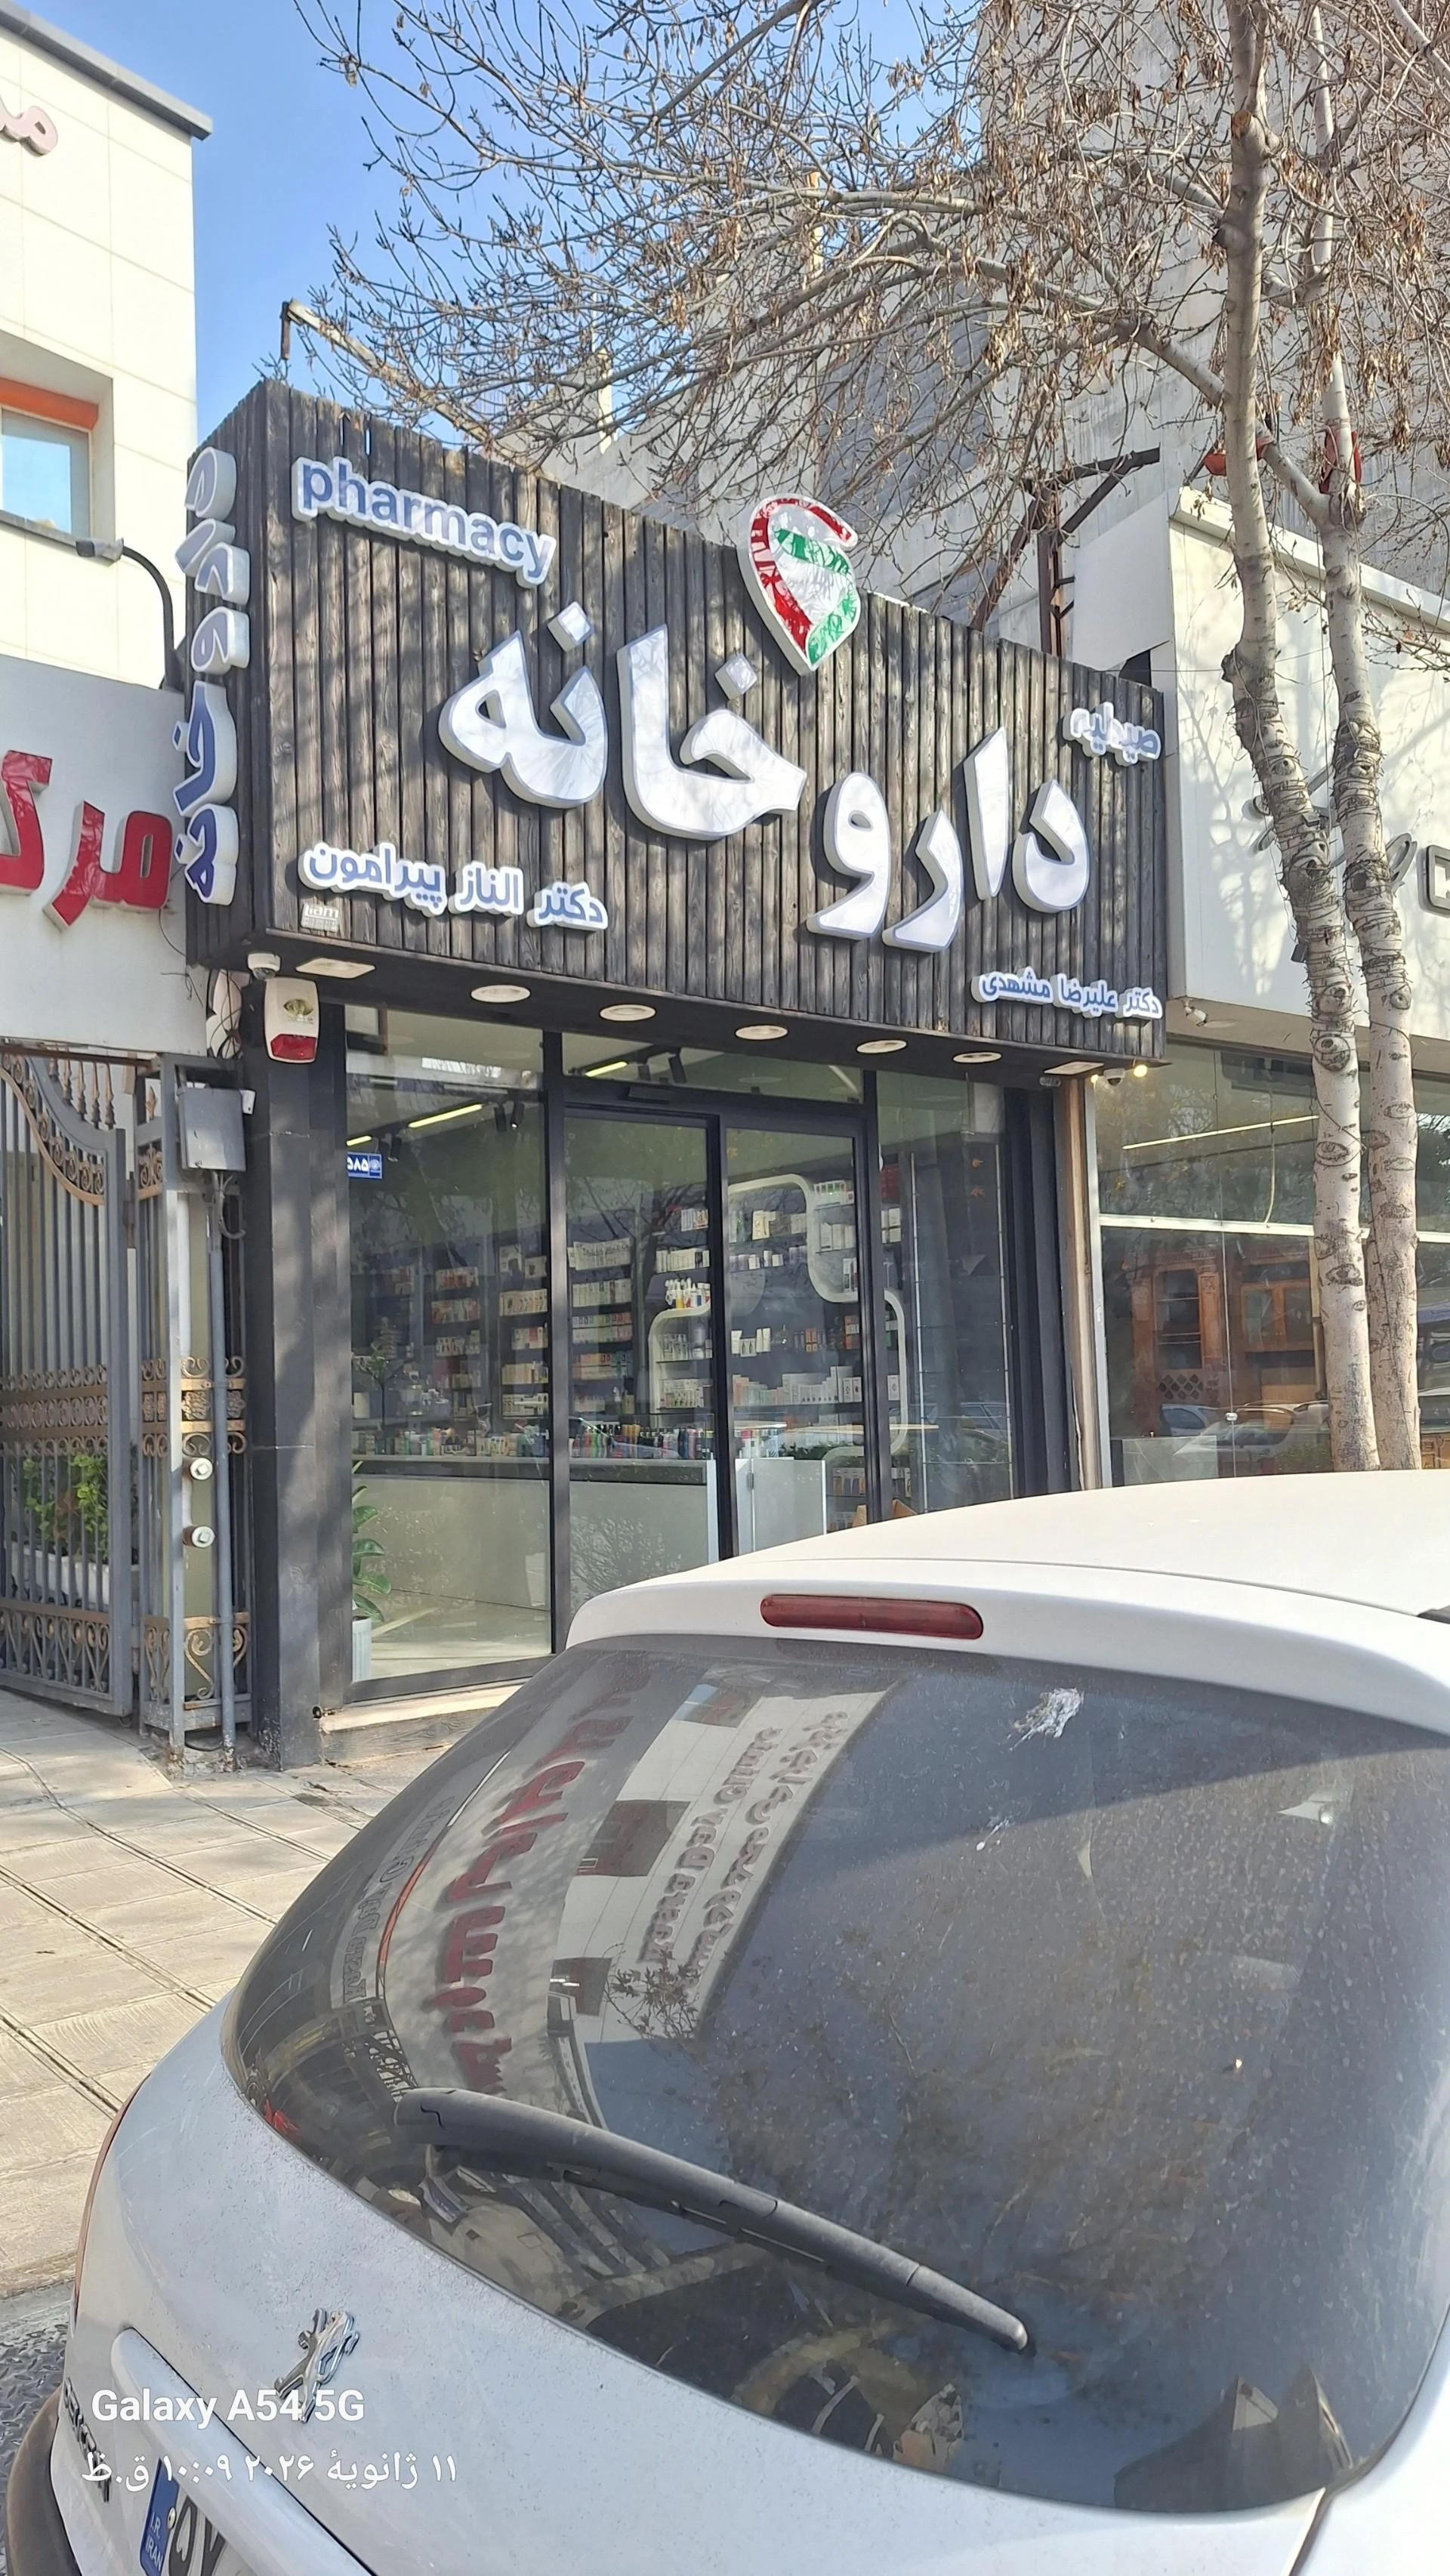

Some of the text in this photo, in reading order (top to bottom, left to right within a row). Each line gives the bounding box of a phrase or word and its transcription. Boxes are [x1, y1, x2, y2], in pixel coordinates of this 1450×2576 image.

[301, 461, 555, 579] pharmacy
[0, 751, 172, 927] مرک
[308, 847, 605, 924] دکتر الناز پیرامون
[981, 970, 1161, 1015] دکتر علیرضا مشهدی
[145, 2534, 164, 2571] IRAN
